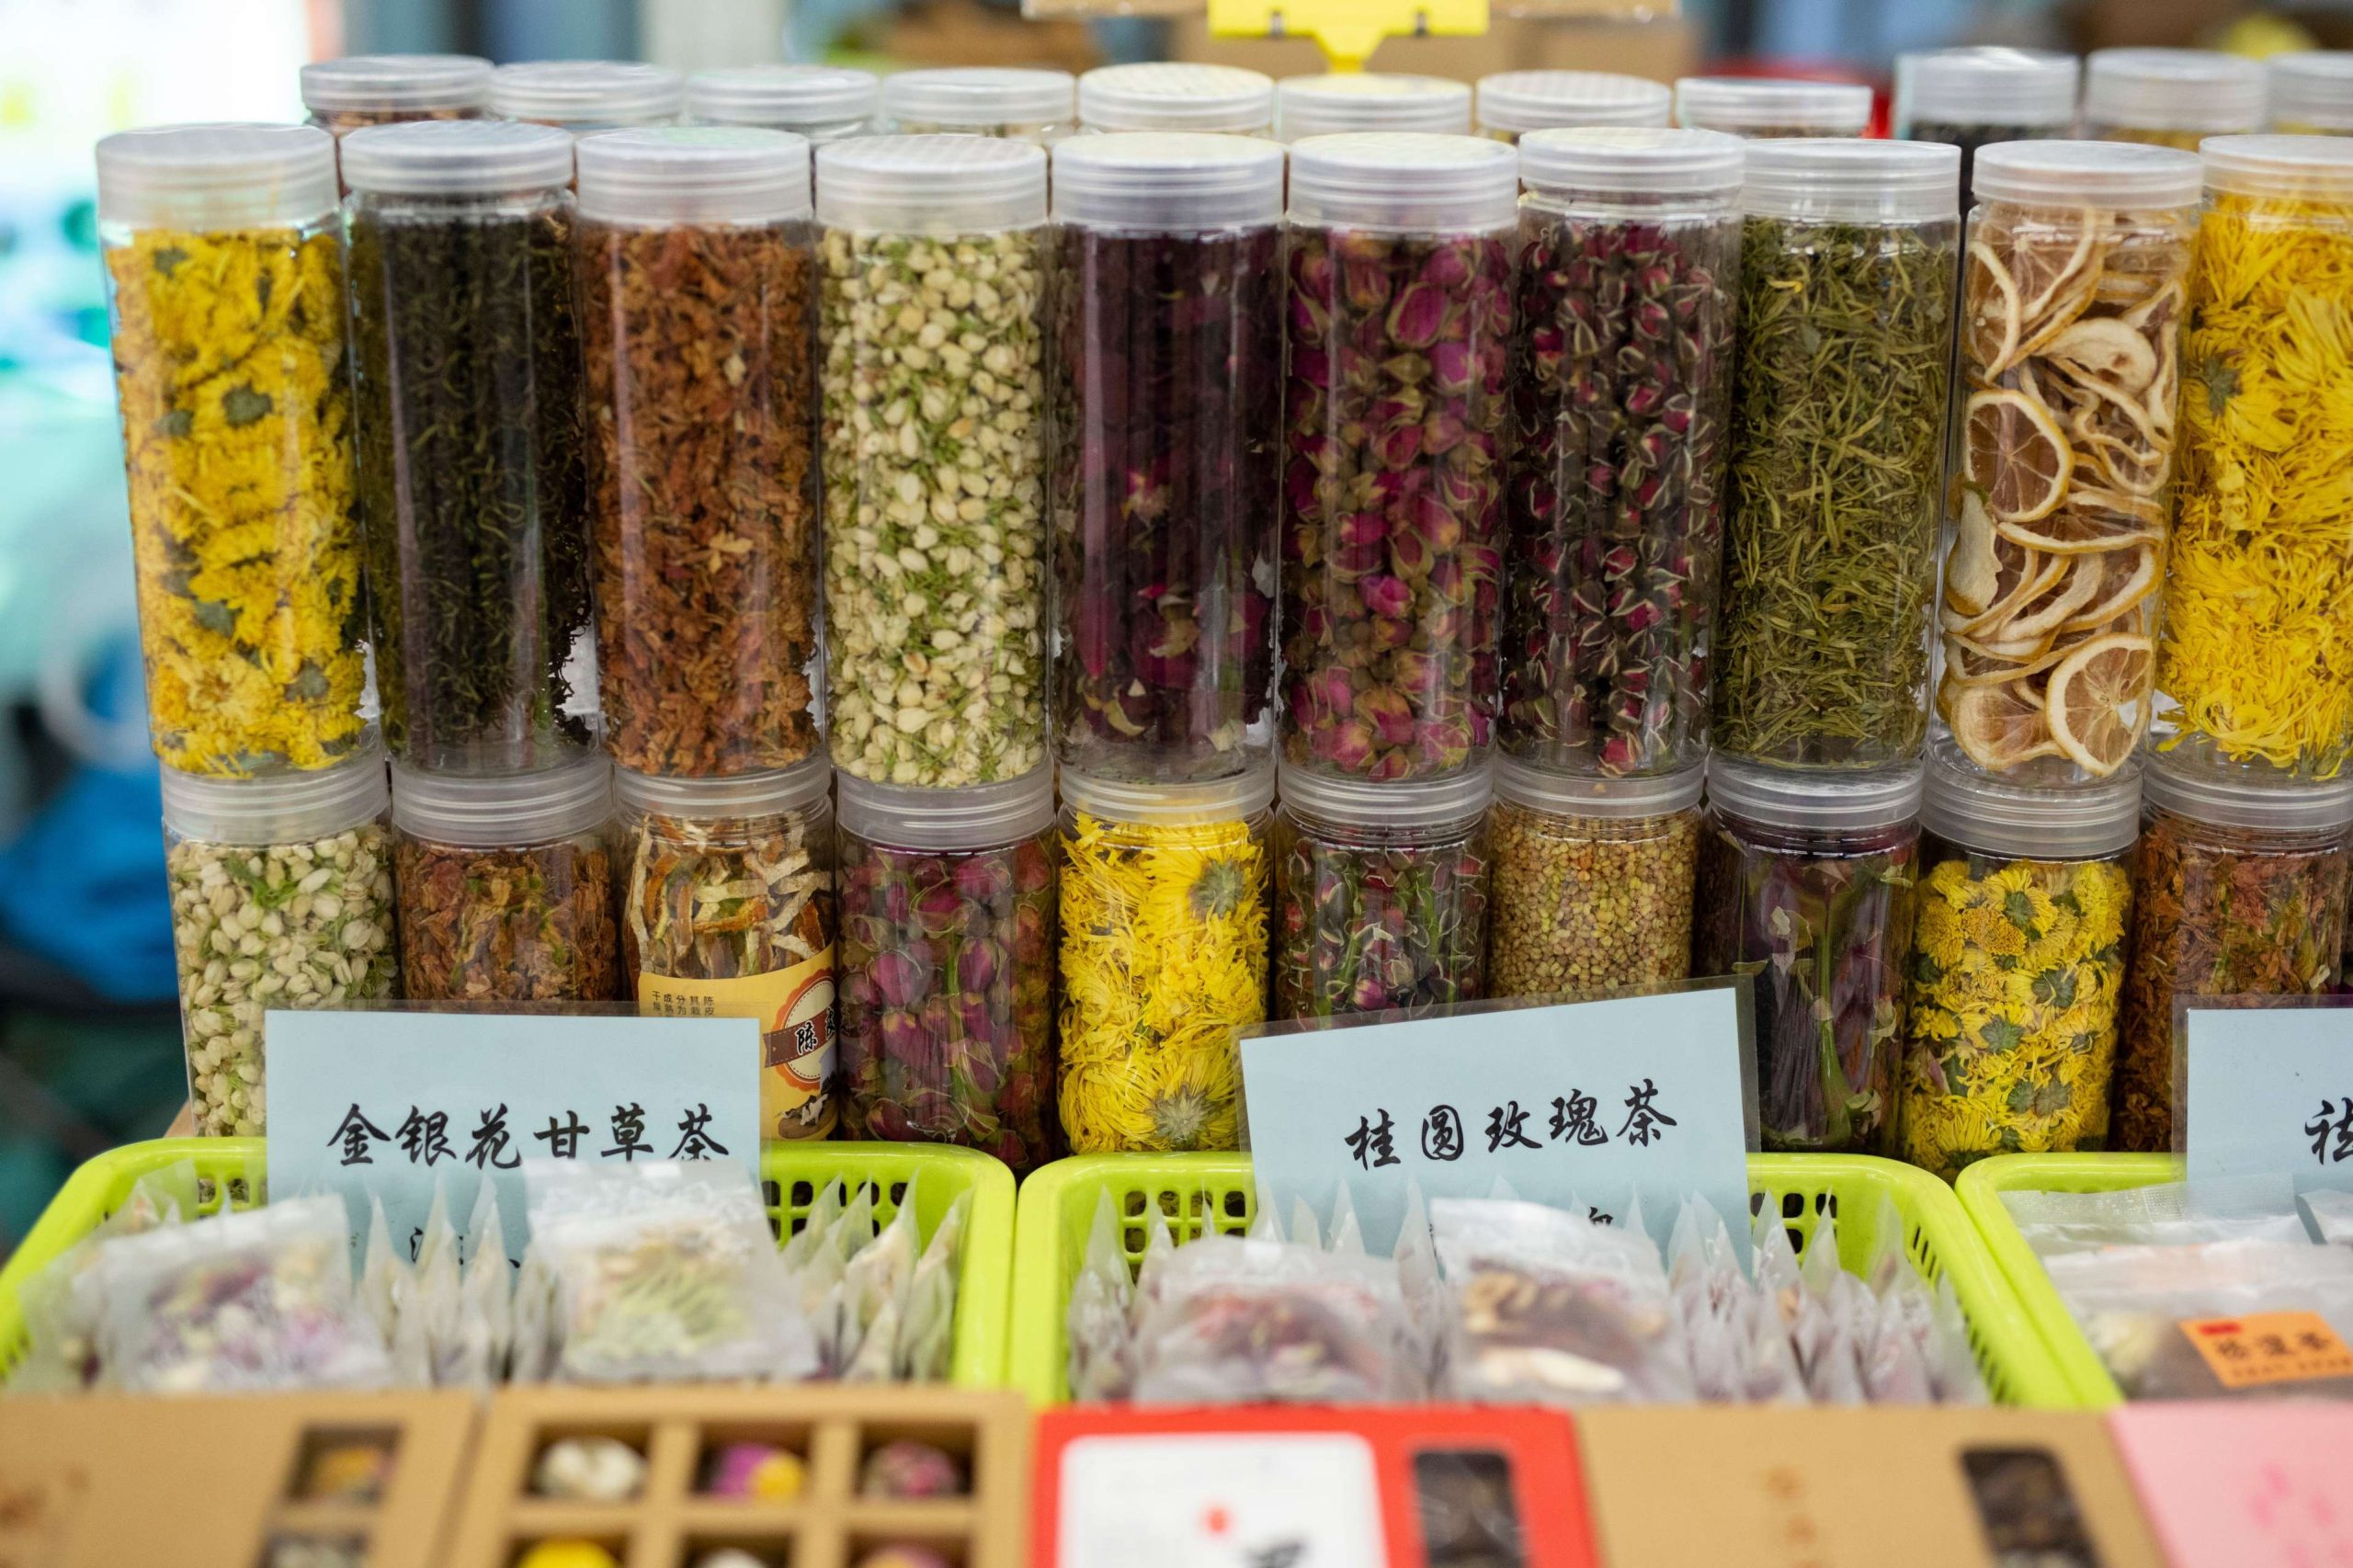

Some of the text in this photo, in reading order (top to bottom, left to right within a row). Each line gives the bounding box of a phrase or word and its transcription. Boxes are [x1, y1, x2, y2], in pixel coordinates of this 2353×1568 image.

[327, 1102, 729, 1170] 金银花甘草茶
[1344, 1078, 1677, 1171] 桂圆玫瑰茶
